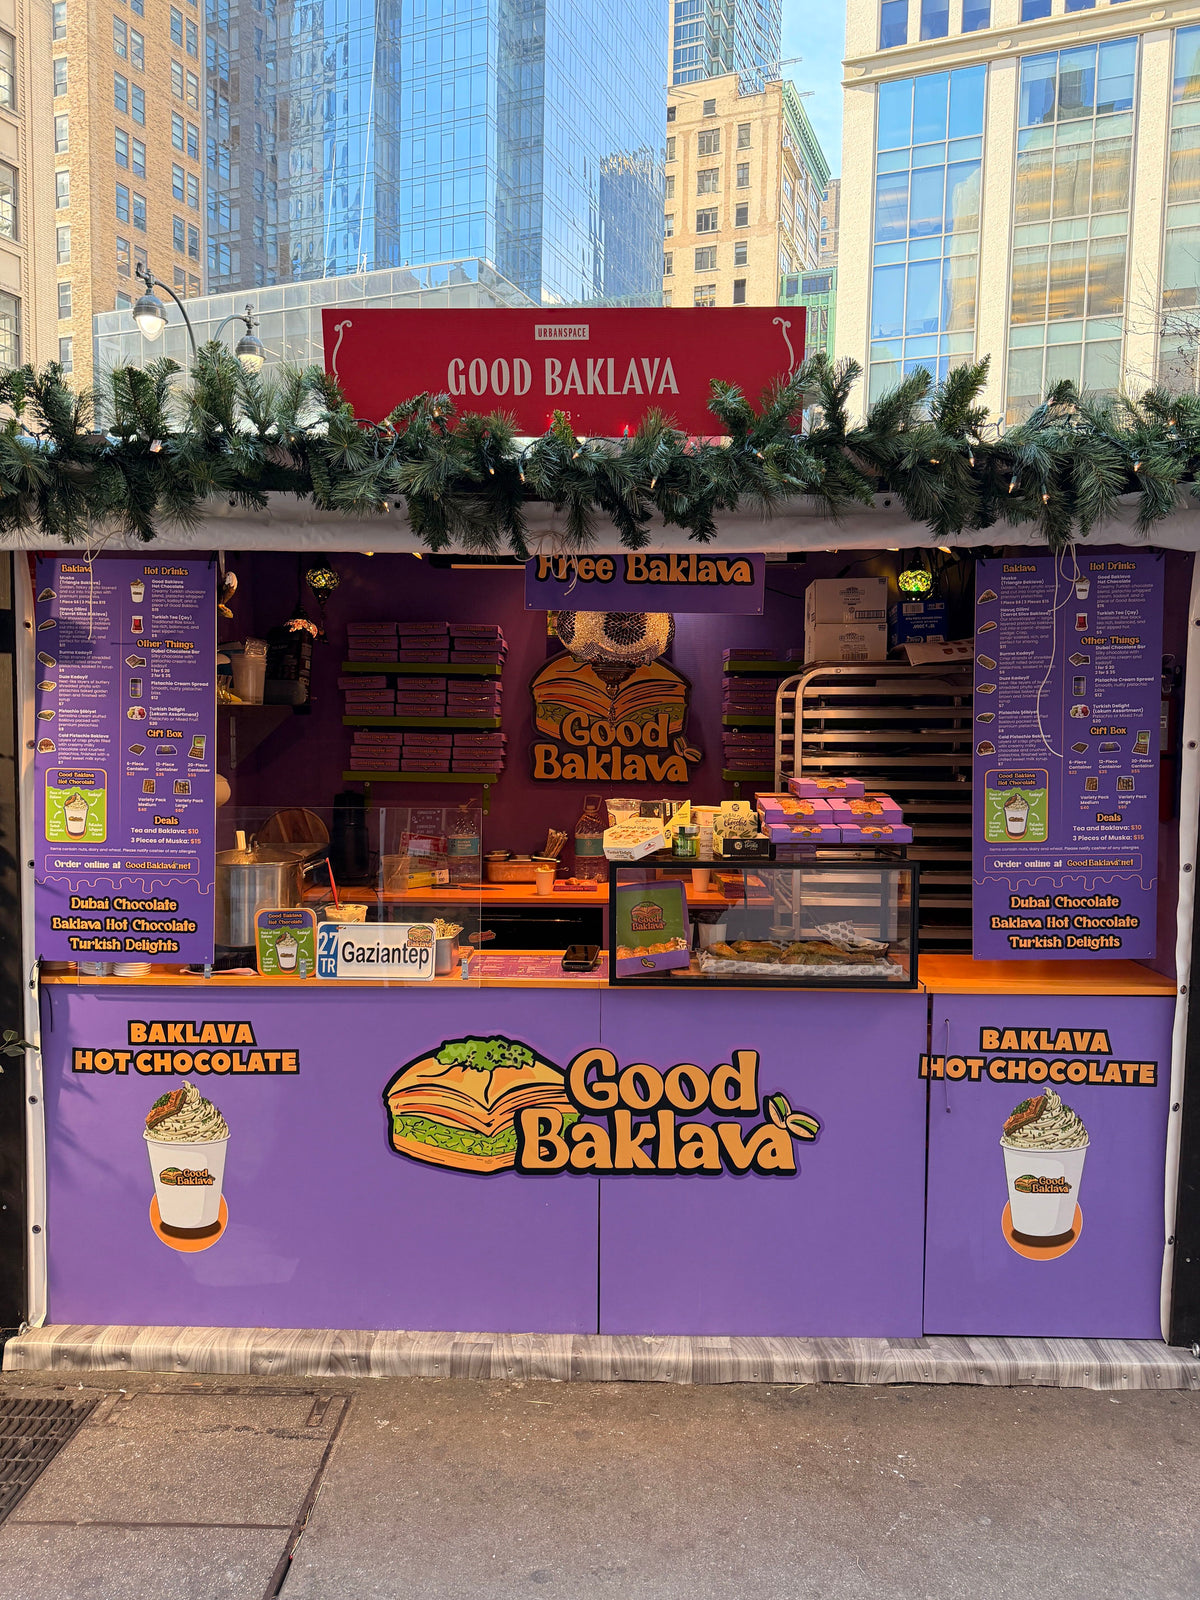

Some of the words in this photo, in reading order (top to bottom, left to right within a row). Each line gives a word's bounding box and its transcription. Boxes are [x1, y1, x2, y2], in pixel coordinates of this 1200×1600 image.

[538, 328, 586, 337] URBANSPACE
[448, 358, 532, 396] GOOD
[545, 358, 679, 396] BAKLAVA
[538, 554, 613, 580] Free
[627, 554, 751, 583] Baklava
[165, 640, 194, 649] Things
[1110, 636, 1140, 645] Things
[147, 729, 163, 737] Gift
[562, 711, 669, 748] Good
[534, 744, 688, 782] Baklava
[154, 816, 178, 825] Deals
[1097, 813, 1121, 822] Deals
[54, 860, 81, 869] Order
[84, 861, 109, 870] online
[1025, 860, 1050, 868] online
[71, 897, 109, 909] Dubai
[113, 898, 177, 910] Chocolate
[1010, 897, 1050, 908] Dubai
[1054, 896, 1119, 908] Chocolate
[52, 918, 100, 930] Baklava
[106, 918, 128, 930] Hot
[132, 919, 196, 931] Chocolate
[991, 917, 1042, 928] Baklava
[1047, 917, 1069, 928] Hot
[1074, 916, 1138, 928] Chocolate
[70, 938, 120, 950] Turkish
[125, 939, 178, 953] Delights
[319, 932, 338, 955] 27
[1010, 936, 1061, 948] Turkish
[1067, 936, 1120, 949] Delights
[342, 942, 429, 969] Gaziantep
[321, 958, 335, 973] TR
[130, 1023, 253, 1043] BAKLAVA
[982, 1030, 1108, 1052] BAKLAVA
[75, 1051, 133, 1072] HOT
[137, 1052, 296, 1072] CHOCOLATE
[922, 1057, 983, 1078] HOT
[990, 1060, 1155, 1083] CHOCOLATE
[569, 1049, 758, 1111] Good
[521, 1109, 796, 1170] Baklava
[184, 1169, 208, 1178] Good
[177, 1177, 213, 1185] Baklava
[1039, 1176, 1064, 1185] Good
[1032, 1184, 1069, 1193] Baklava
